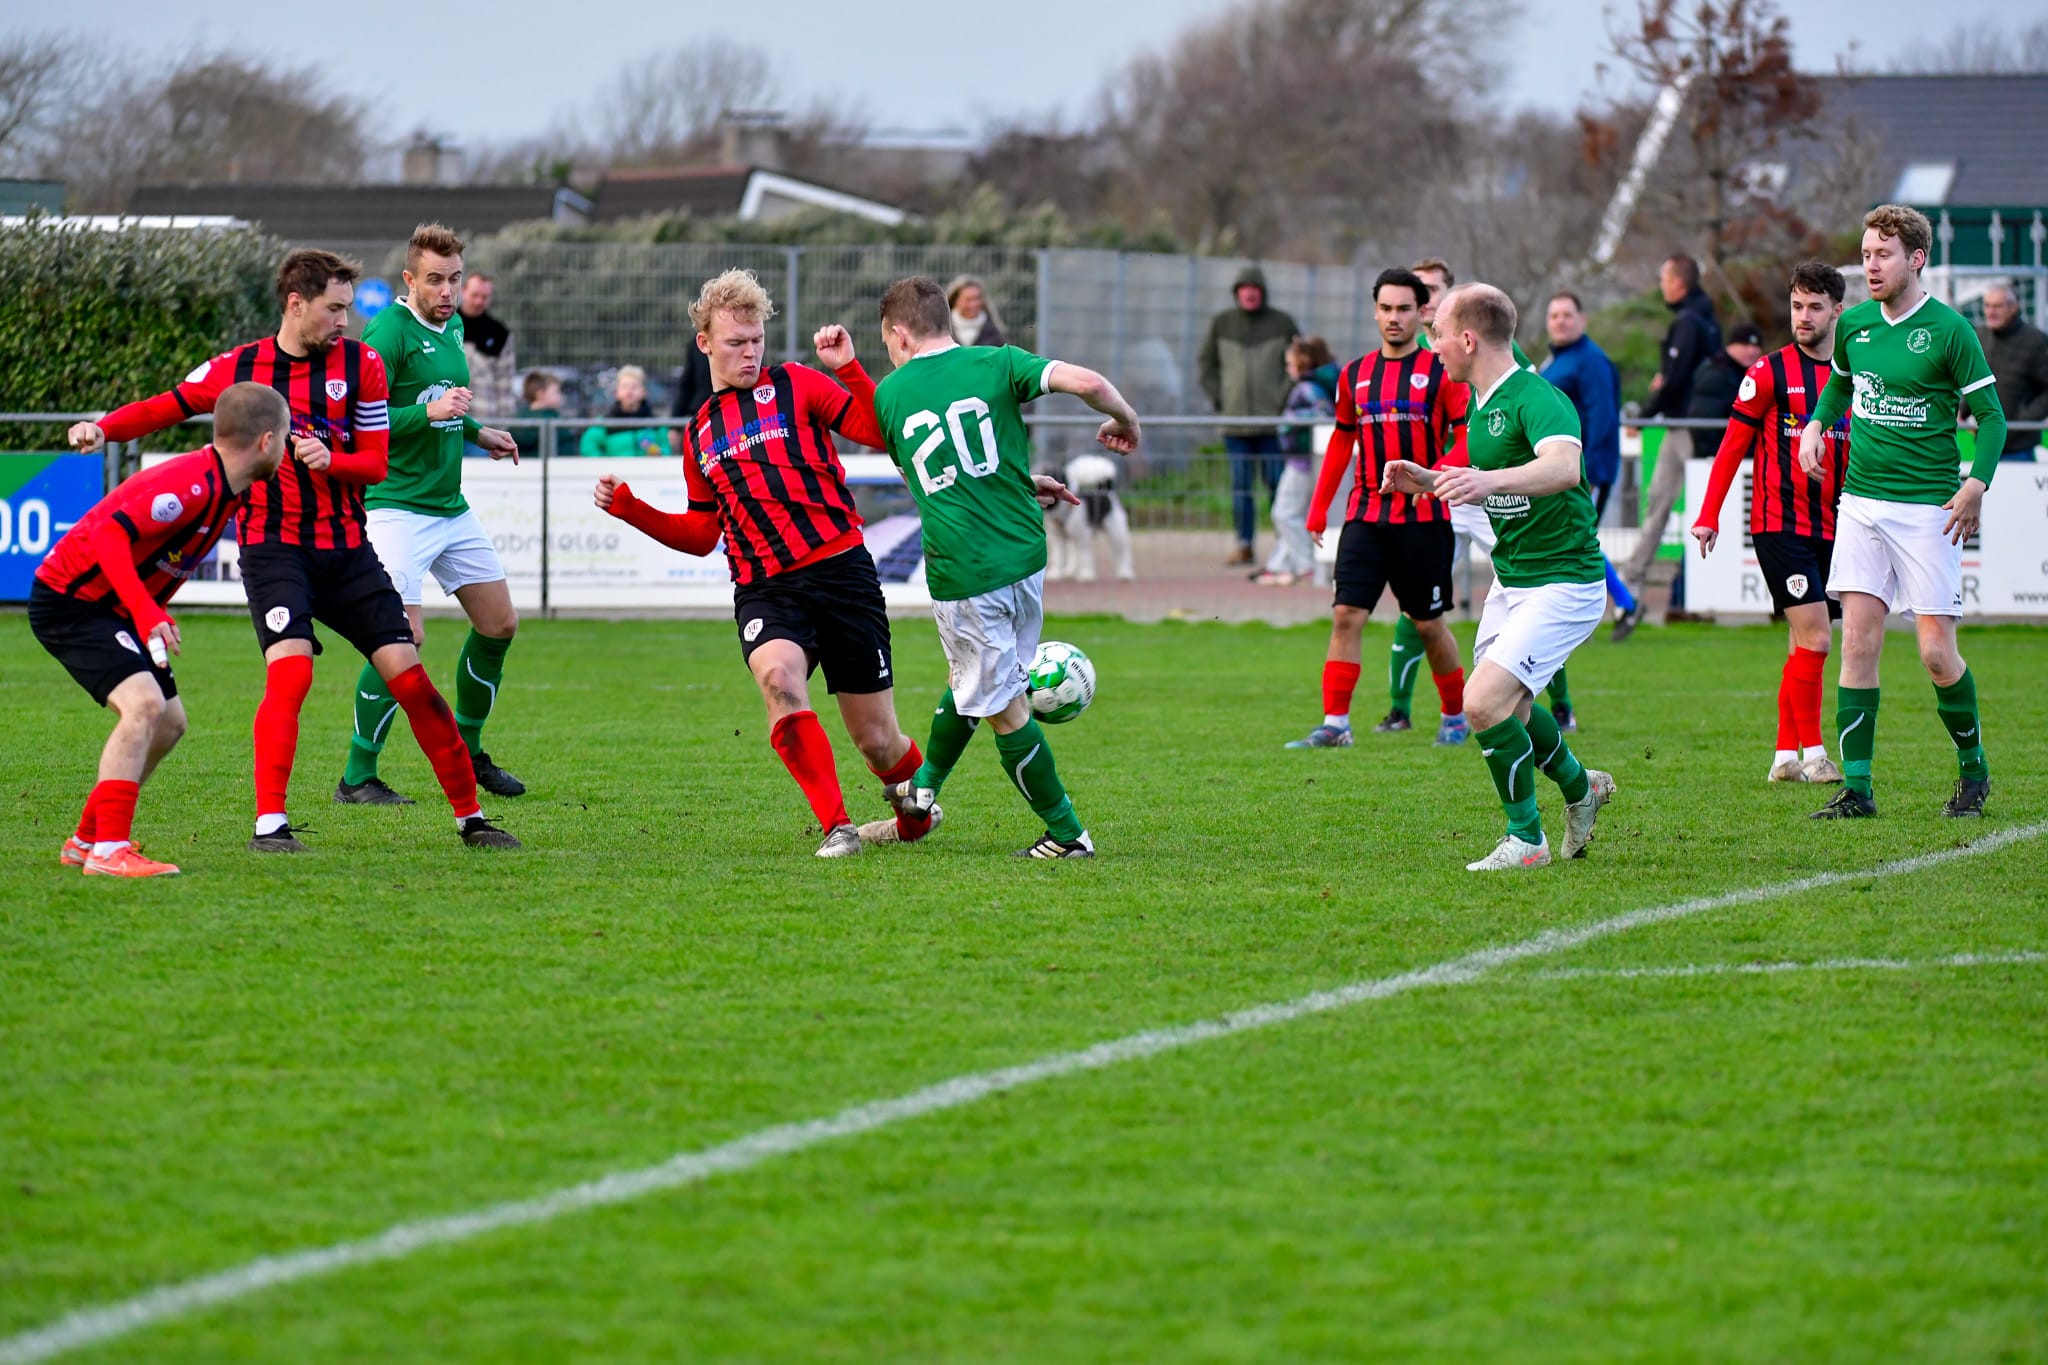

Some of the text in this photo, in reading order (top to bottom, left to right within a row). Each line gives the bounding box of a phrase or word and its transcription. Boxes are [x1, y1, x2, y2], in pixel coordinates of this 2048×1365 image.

[1786, 386, 1806, 394] JAKO
[722, 446, 738, 459] THE
[739, 428, 790, 452] DIFFERENCE
[902, 396, 1000, 497] 20
[1433, 586, 1441, 601] 8
